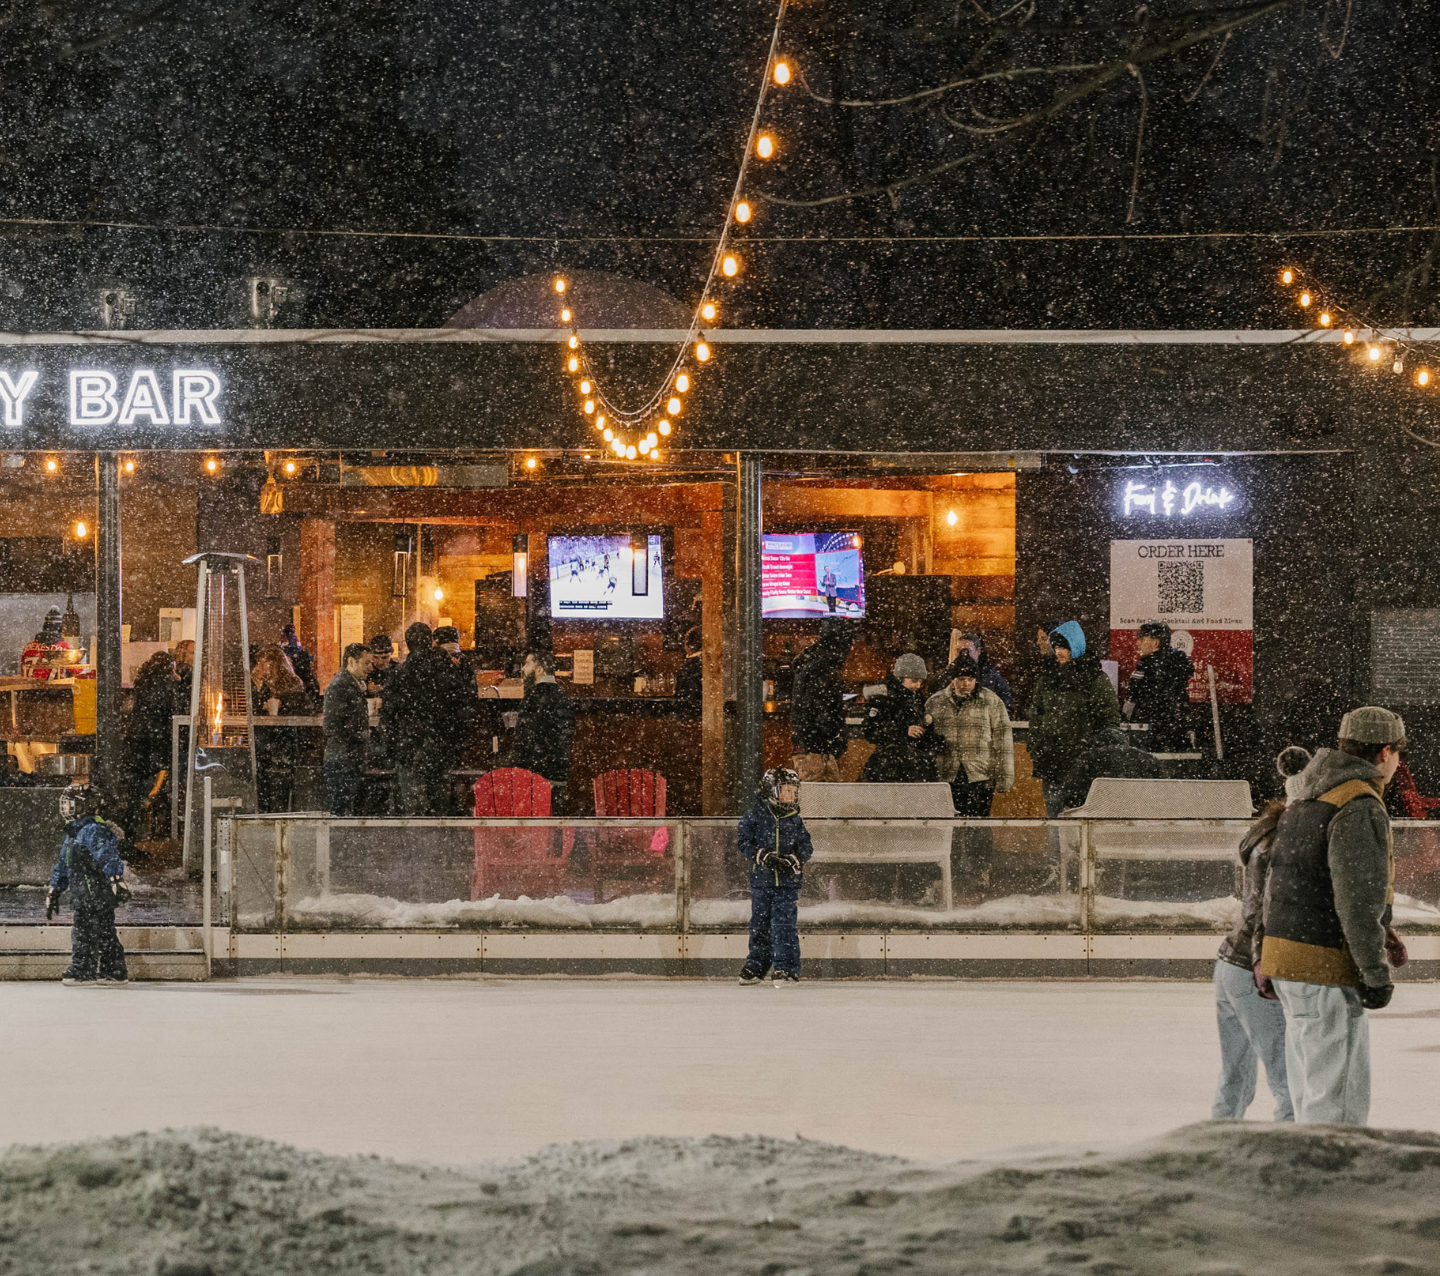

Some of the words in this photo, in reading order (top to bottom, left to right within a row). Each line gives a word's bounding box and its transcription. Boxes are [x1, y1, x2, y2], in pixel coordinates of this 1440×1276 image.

[68, 369, 223, 427] BAR
[1161, 480, 1177, 516] &
[1180, 481, 1235, 515] Drink
[1137, 545, 1184, 559] ORDER
[1187, 544, 1225, 558] HERE
